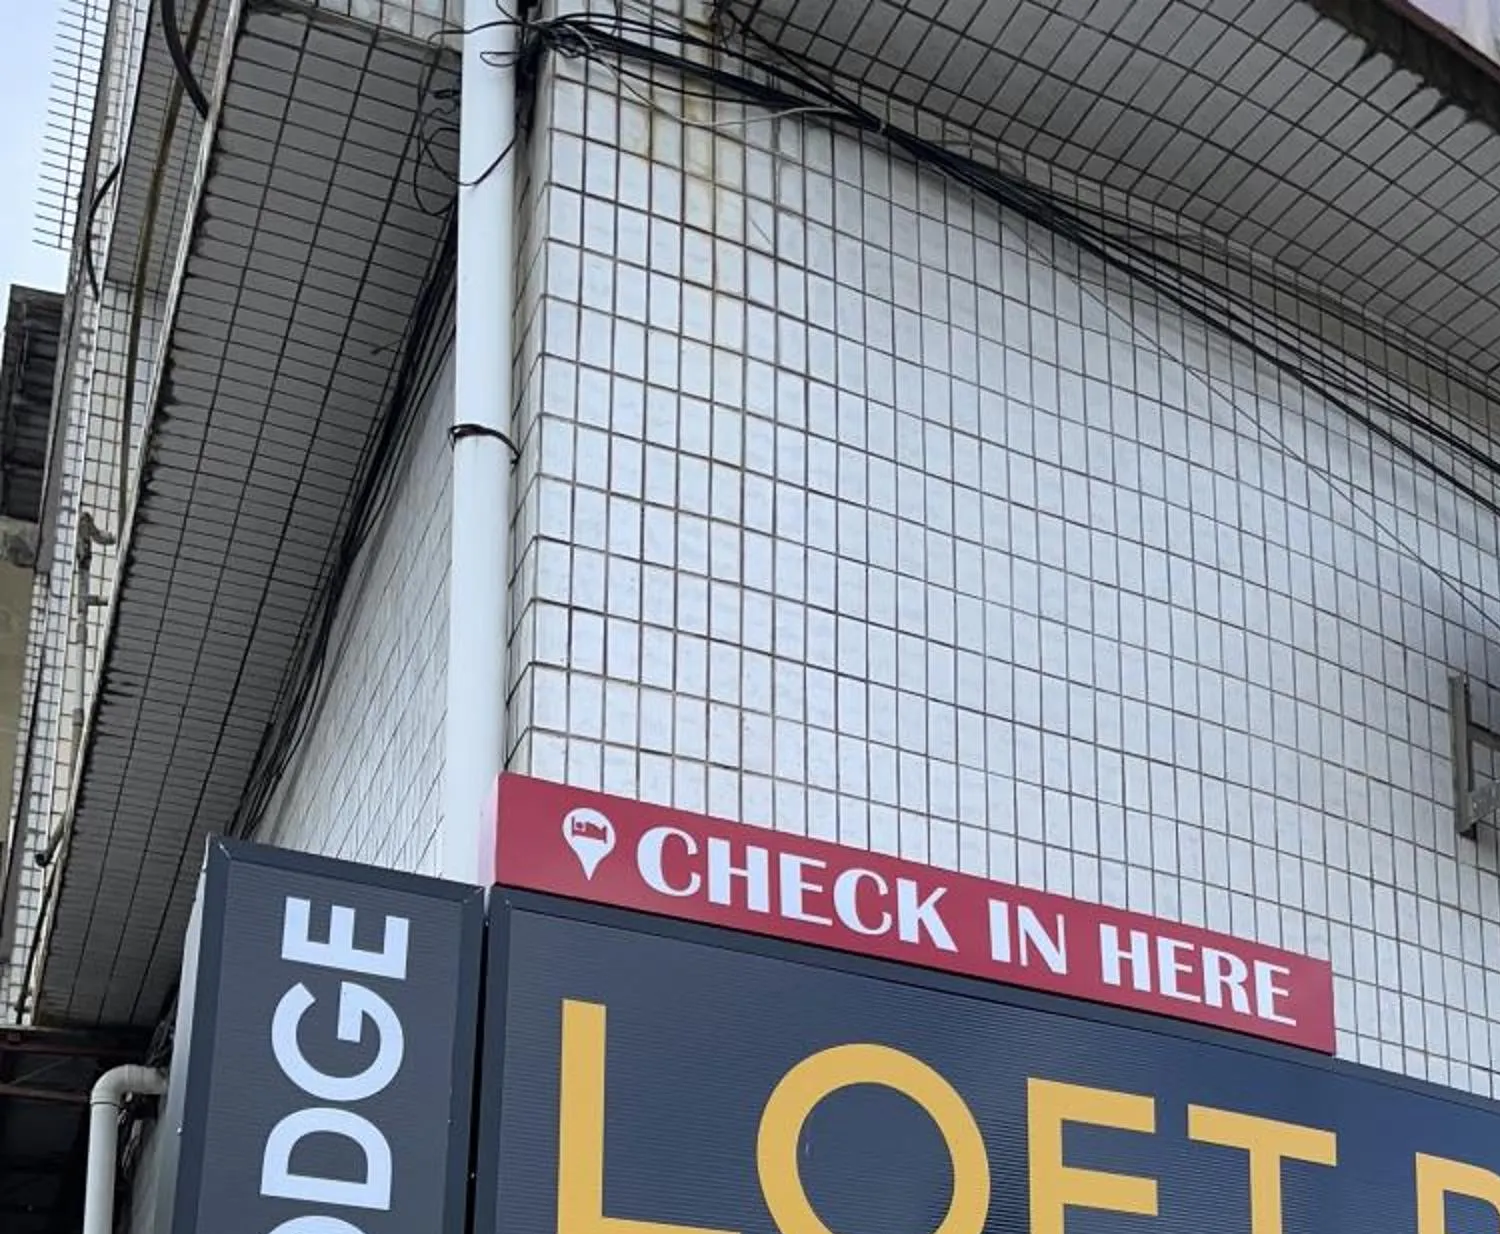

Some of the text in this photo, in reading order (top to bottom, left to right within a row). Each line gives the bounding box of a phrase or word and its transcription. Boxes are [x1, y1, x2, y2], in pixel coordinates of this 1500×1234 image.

[636, 826, 1297, 1027] CHECK IN HERE
